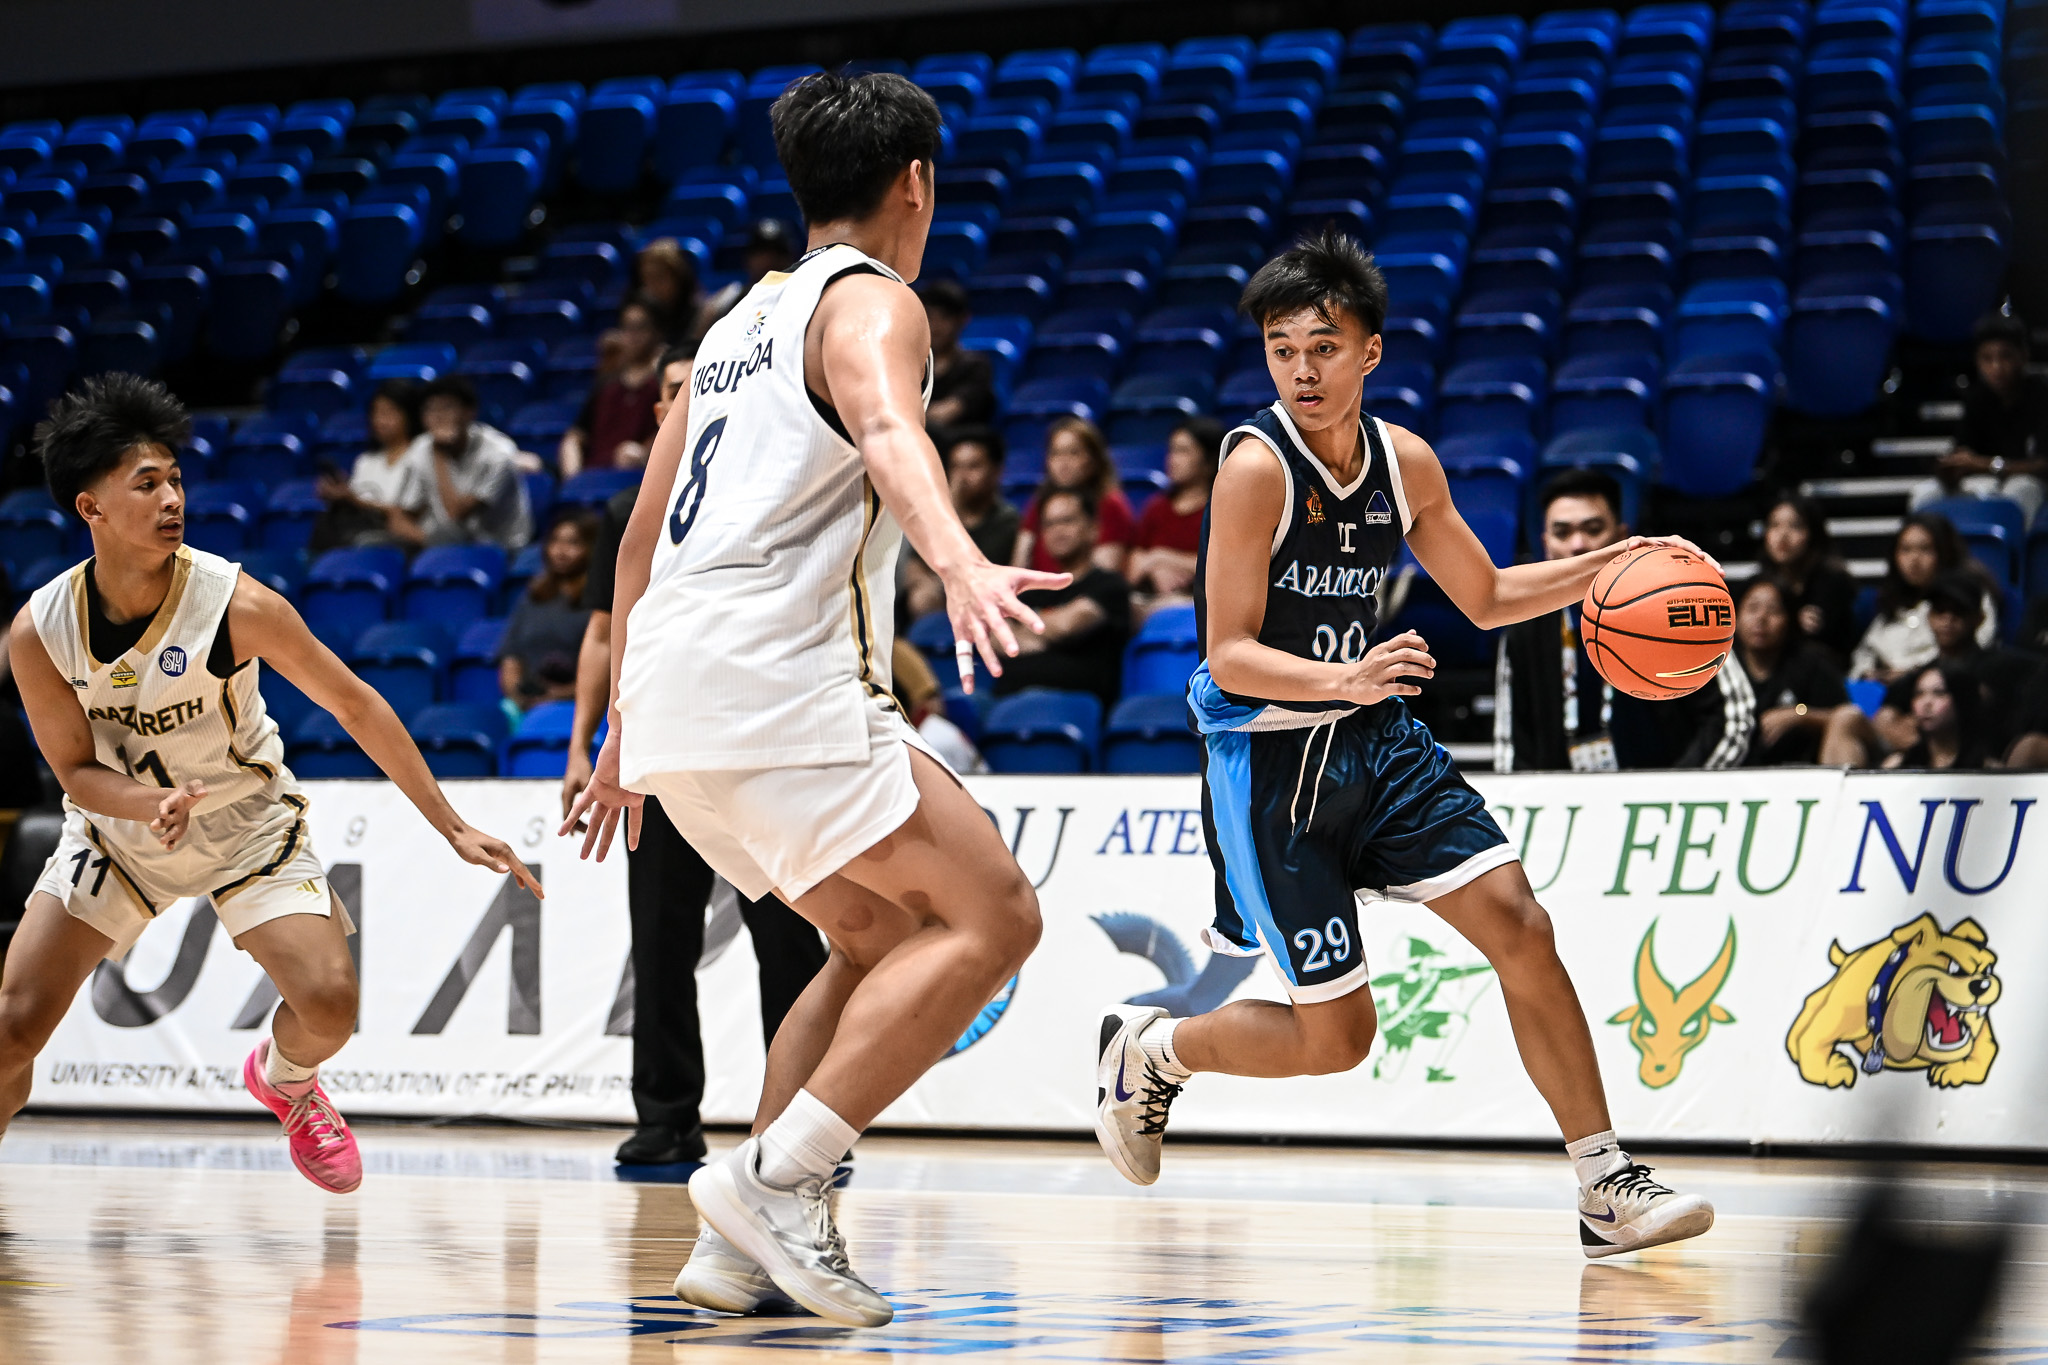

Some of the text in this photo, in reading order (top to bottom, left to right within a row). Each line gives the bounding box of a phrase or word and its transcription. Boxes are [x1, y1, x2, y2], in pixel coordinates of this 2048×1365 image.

[693, 337, 774, 398] FIGUEOA
[669, 415, 728, 547] 8
[1274, 559, 1385, 598] ADAMSO
[1667, 597, 1729, 606] CHAMPIONSHIP
[1667, 605, 1732, 628] ELITE
[982, 807, 1076, 890] U
[1096, 807, 1208, 856] ATE
[1489, 804, 1583, 893] U
[1604, 800, 1819, 896] FEU
[1840, 799, 2037, 895] NU
[70, 848, 112, 898] 11
[1293, 916, 1351, 973] 29
[50, 1060, 633, 1098] UNIVERSITY ATHL SSOCIATION OF THE PHILIP
